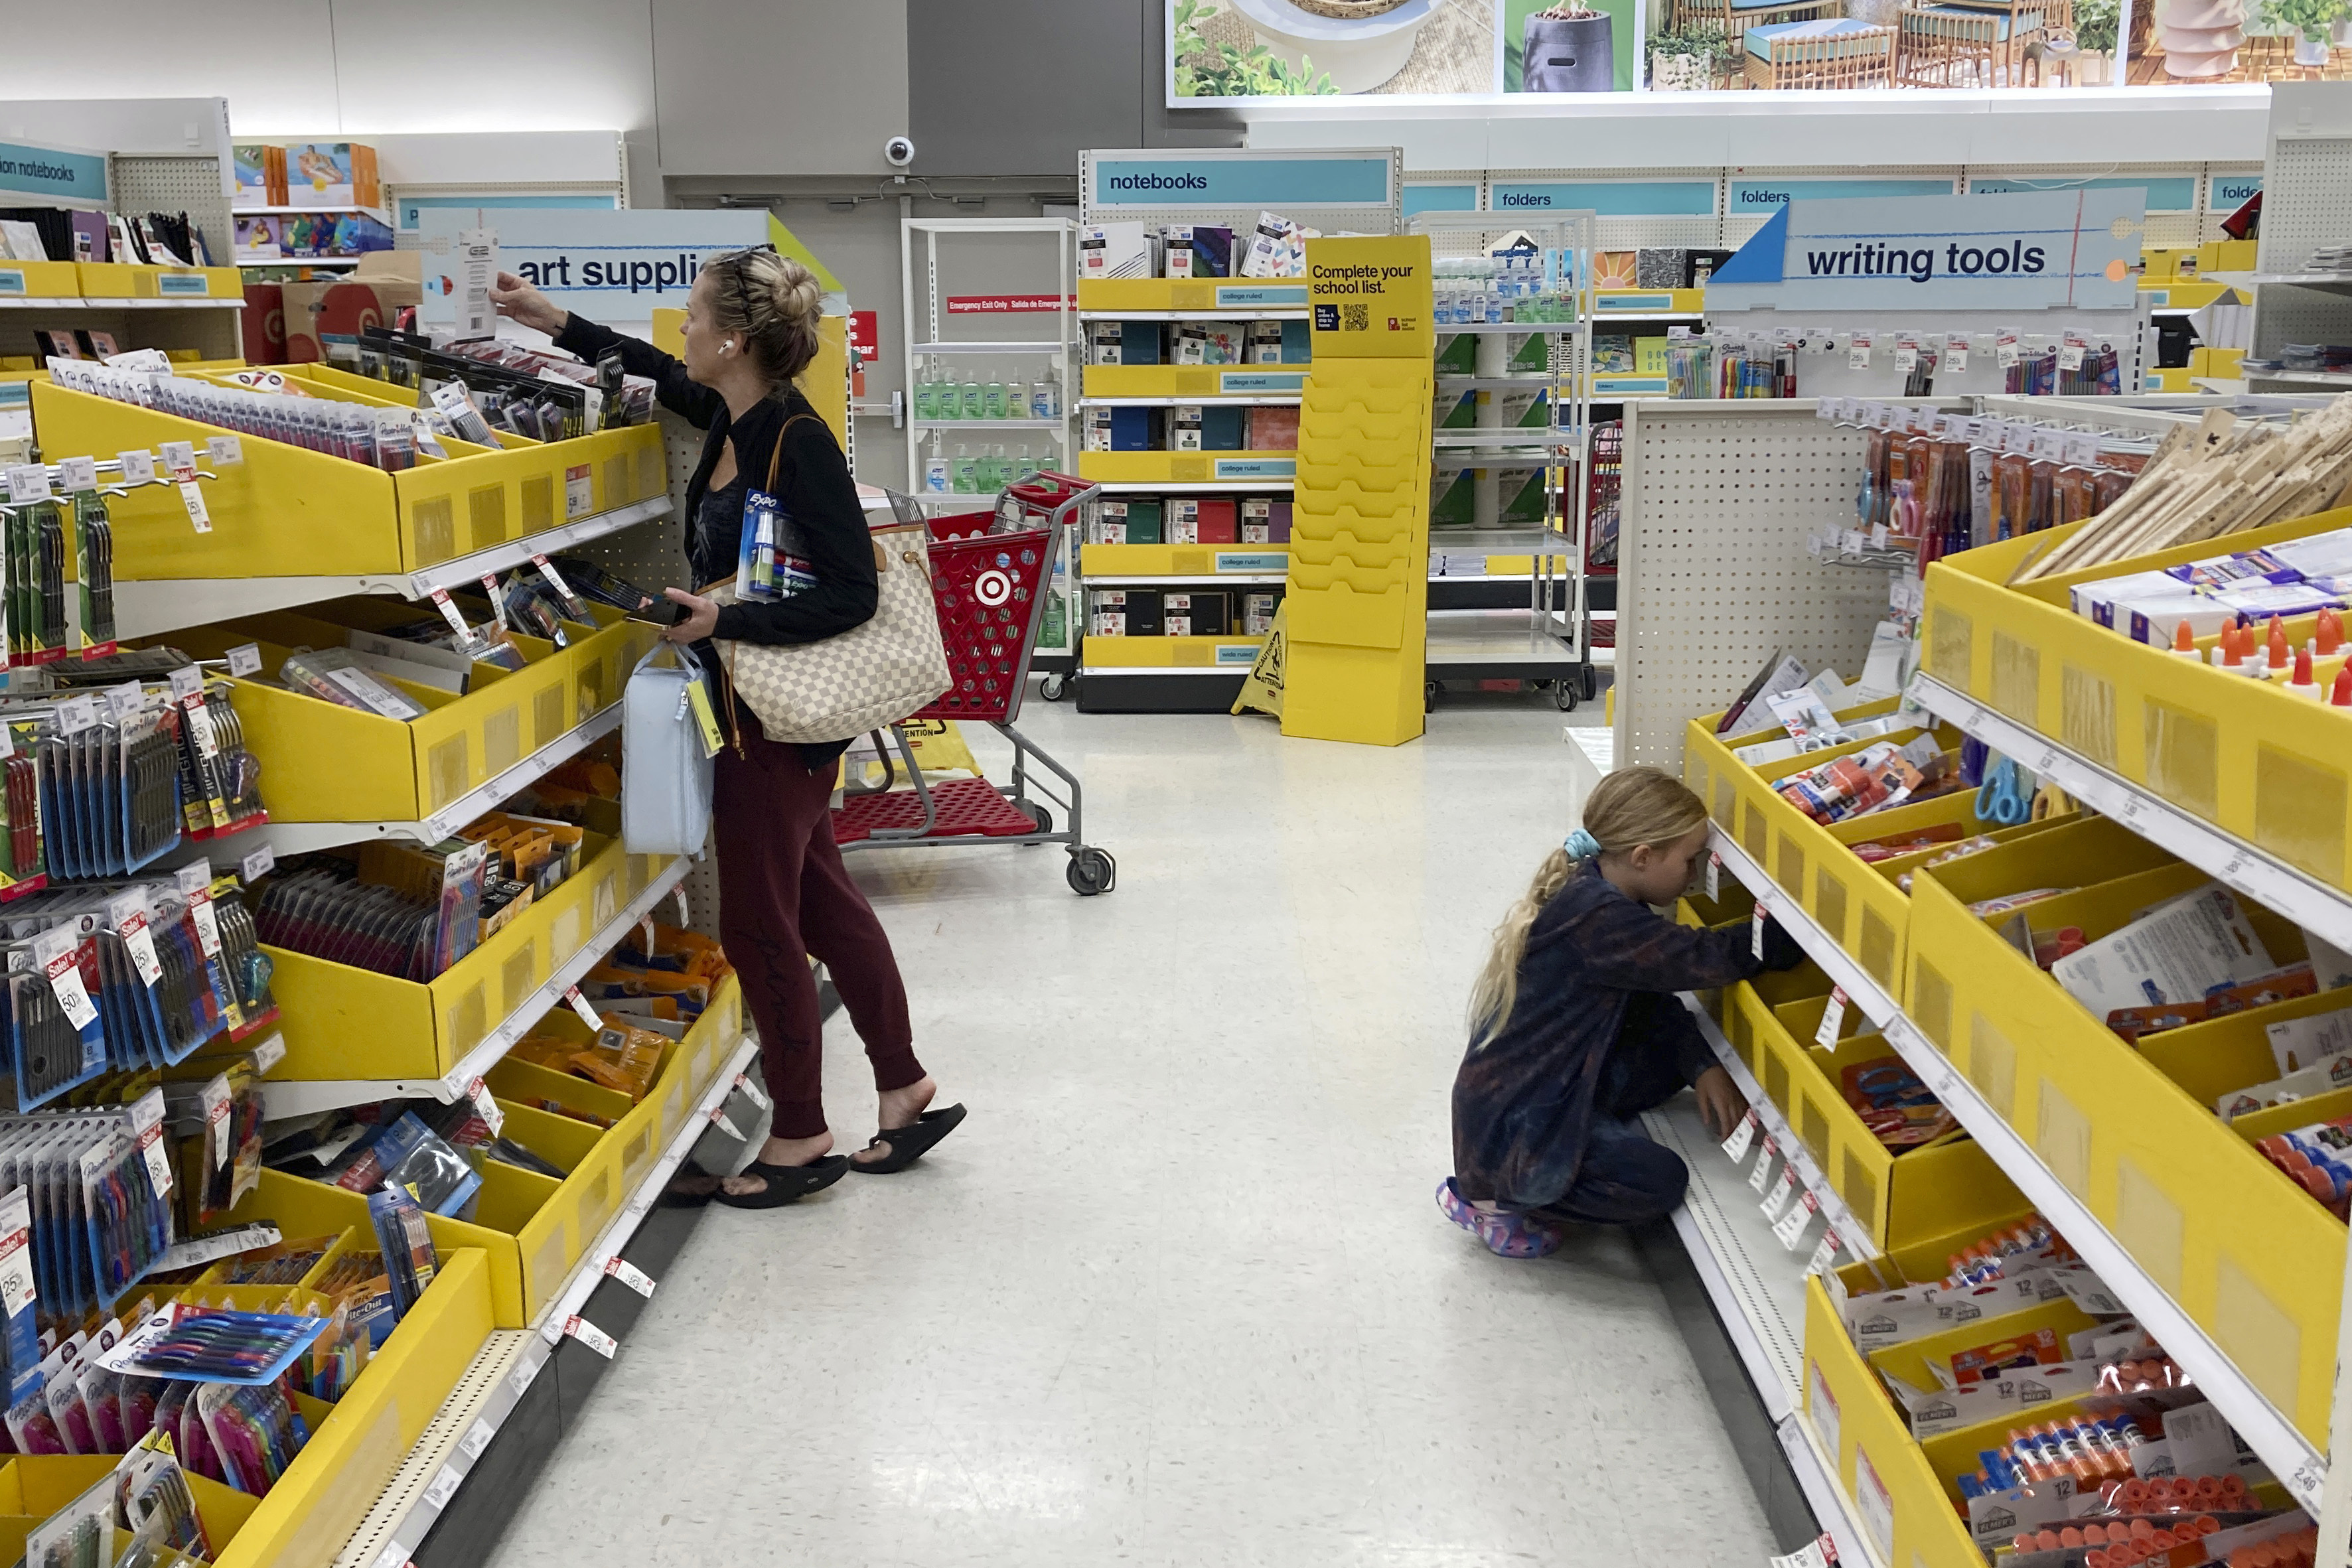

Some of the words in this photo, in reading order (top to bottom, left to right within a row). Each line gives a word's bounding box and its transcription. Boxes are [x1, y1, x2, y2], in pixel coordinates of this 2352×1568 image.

[19, 161, 75, 182] notebooks
[1110, 172, 1207, 190] notebooks
[1502, 193, 1552, 206] folders
[1741, 190, 1791, 203] folders
[1807, 242, 1935, 283] writing
[1946, 240, 2045, 274] tools
[518, 255, 570, 286] art
[581, 253, 707, 294] suppli
[1312, 264, 1378, 281] Complete
[1380, 265, 1414, 281] your
[1313, 280, 1359, 295] school
[1362, 280, 1386, 294] list.
[949, 301, 982, 311] Emergency
[982, 301, 993, 309] Exit
[993, 300, 1008, 310] Only
[749, 493, 777, 508] EXPO
[1258, 640, 1274, 668] CAUTION
[484, 874, 497, 887] 60
[121, 916, 141, 937] Sale!
[47, 957, 70, 978] Sale!
